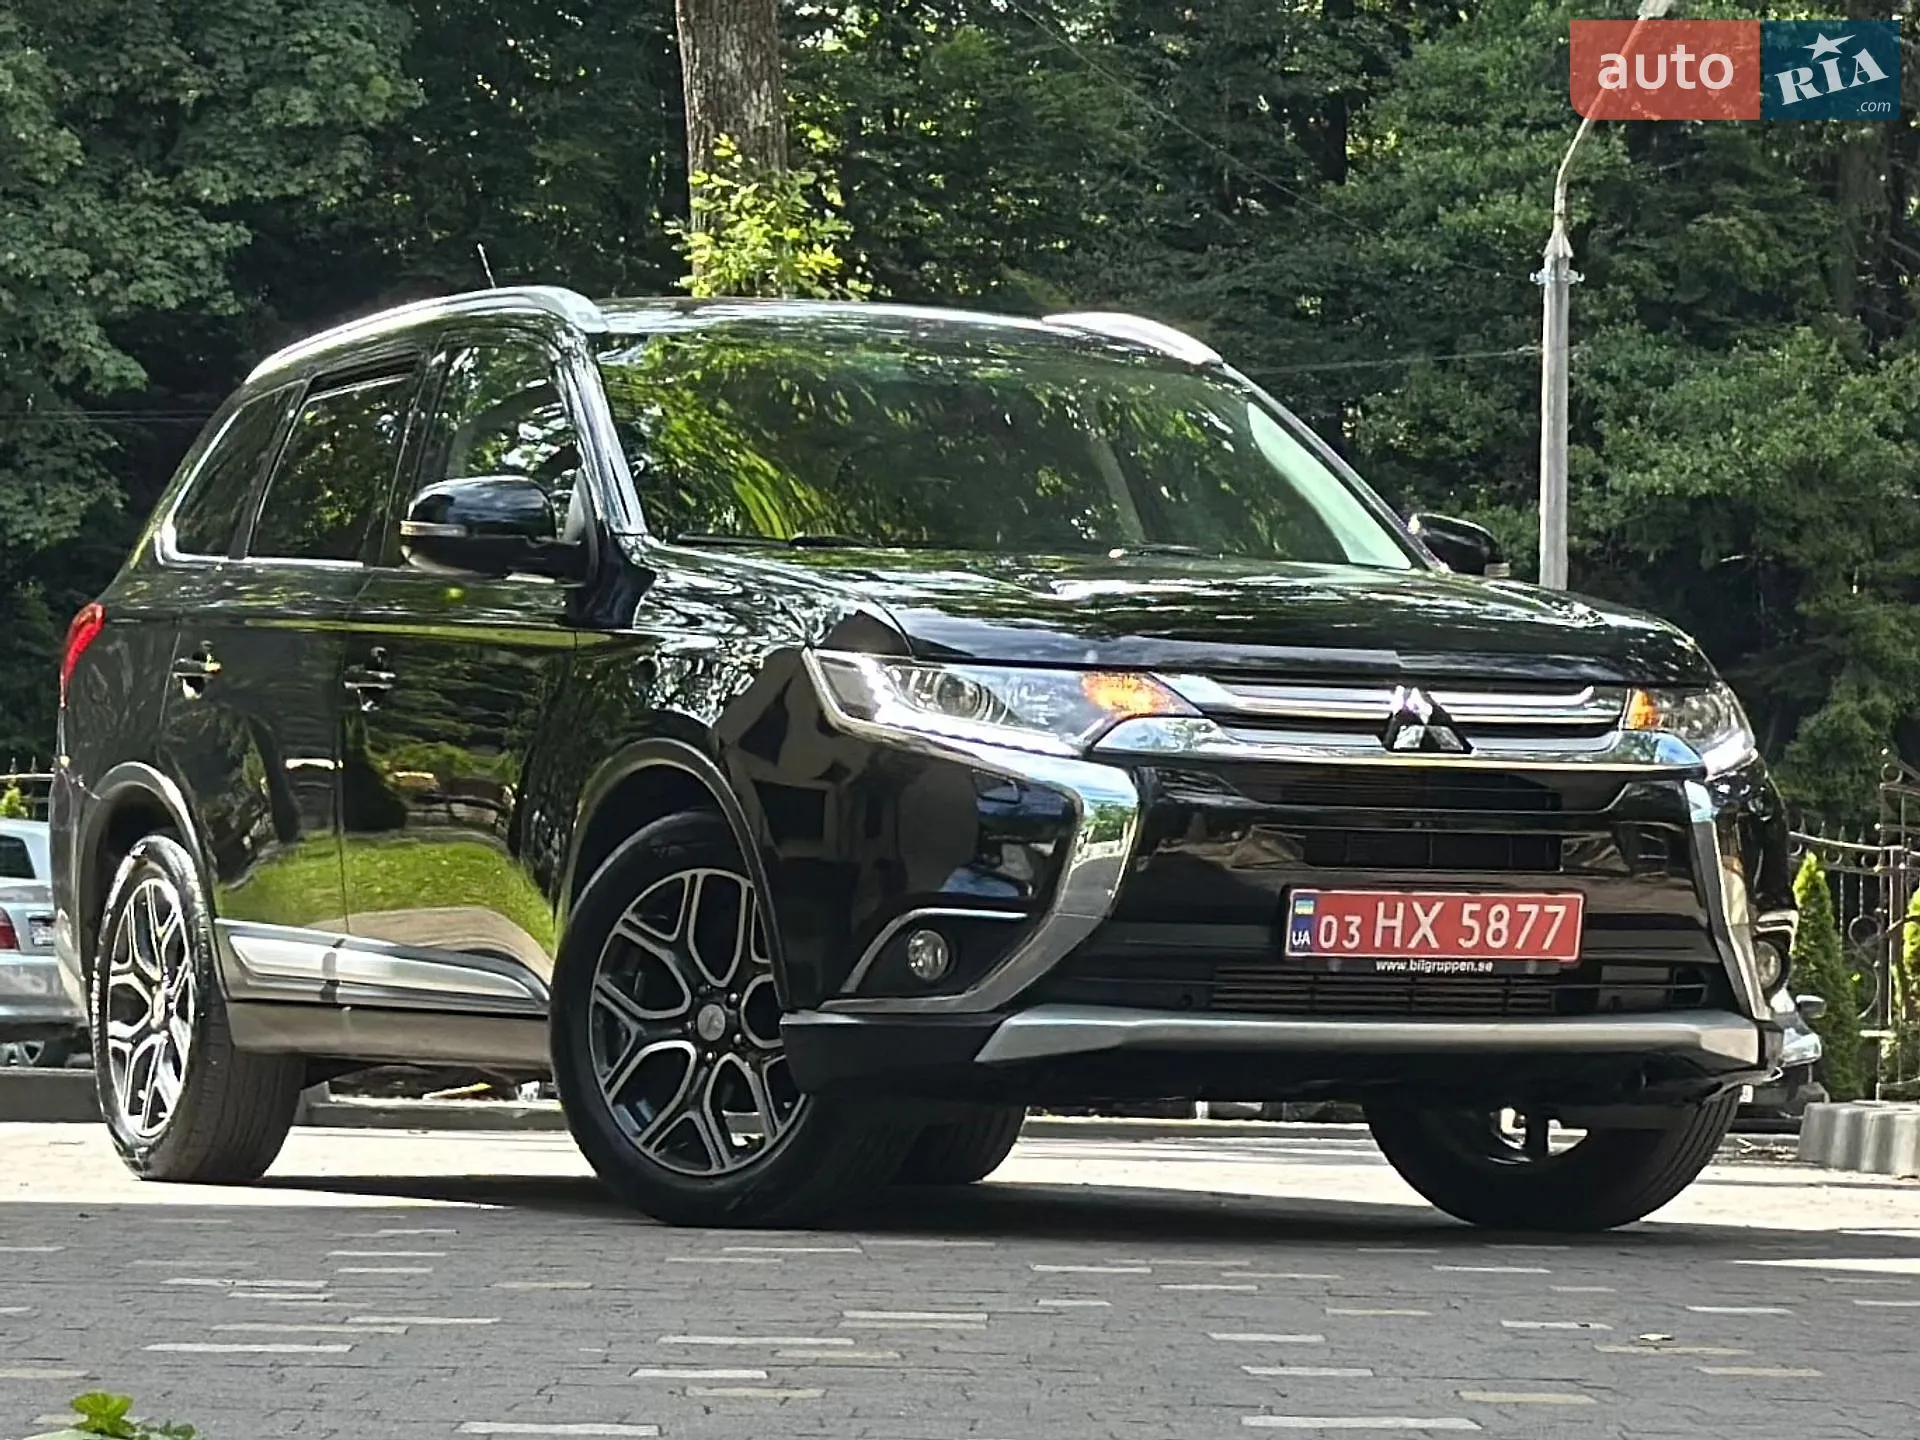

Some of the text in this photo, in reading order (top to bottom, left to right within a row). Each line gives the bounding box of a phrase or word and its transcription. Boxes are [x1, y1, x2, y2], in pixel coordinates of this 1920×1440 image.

[1292, 901, 1567, 950] UA 03 HX 5877
